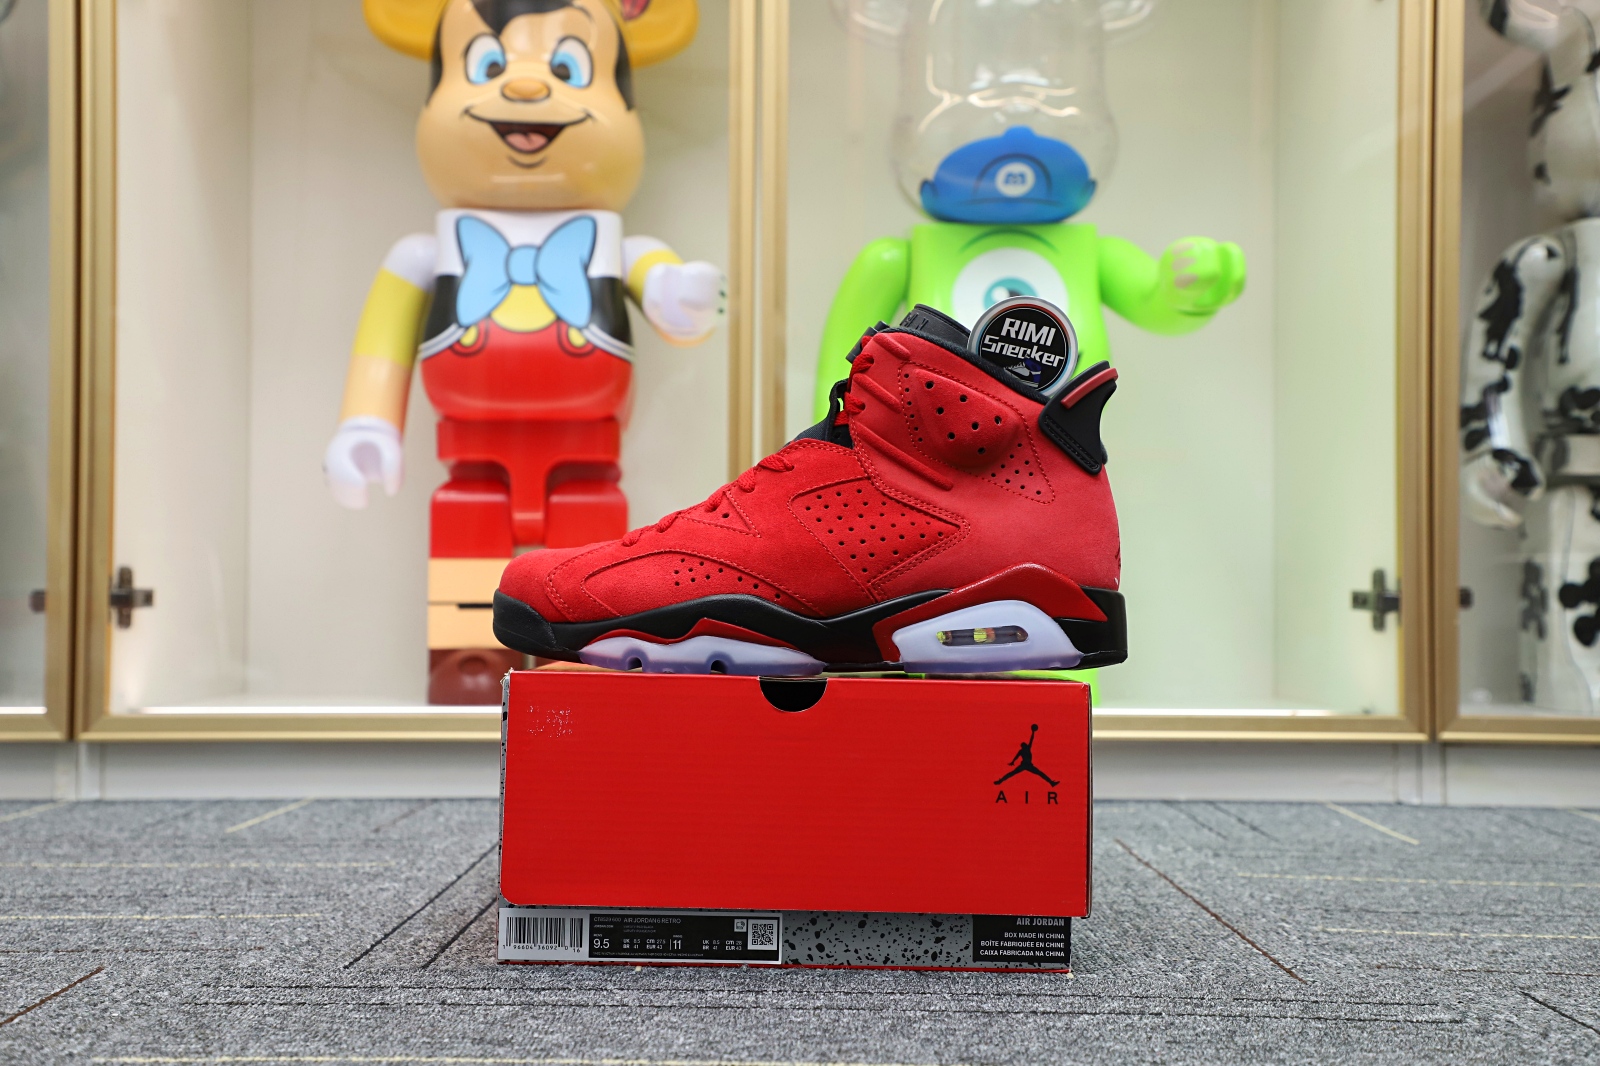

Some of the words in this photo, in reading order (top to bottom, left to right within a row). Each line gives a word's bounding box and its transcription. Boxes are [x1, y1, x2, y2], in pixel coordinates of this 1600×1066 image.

[1000, 317, 1056, 347] RIMI
[981, 334, 1065, 368] Sneaker
[995, 790, 1058, 805] AIR
[1016, 917, 1030, 926] AIR
[1032, 917, 1065, 926] JORDAN
[593, 938, 610, 949] 9.5
[673, 939, 681, 950] 11
[980, 939, 999, 947] BOÎTE
